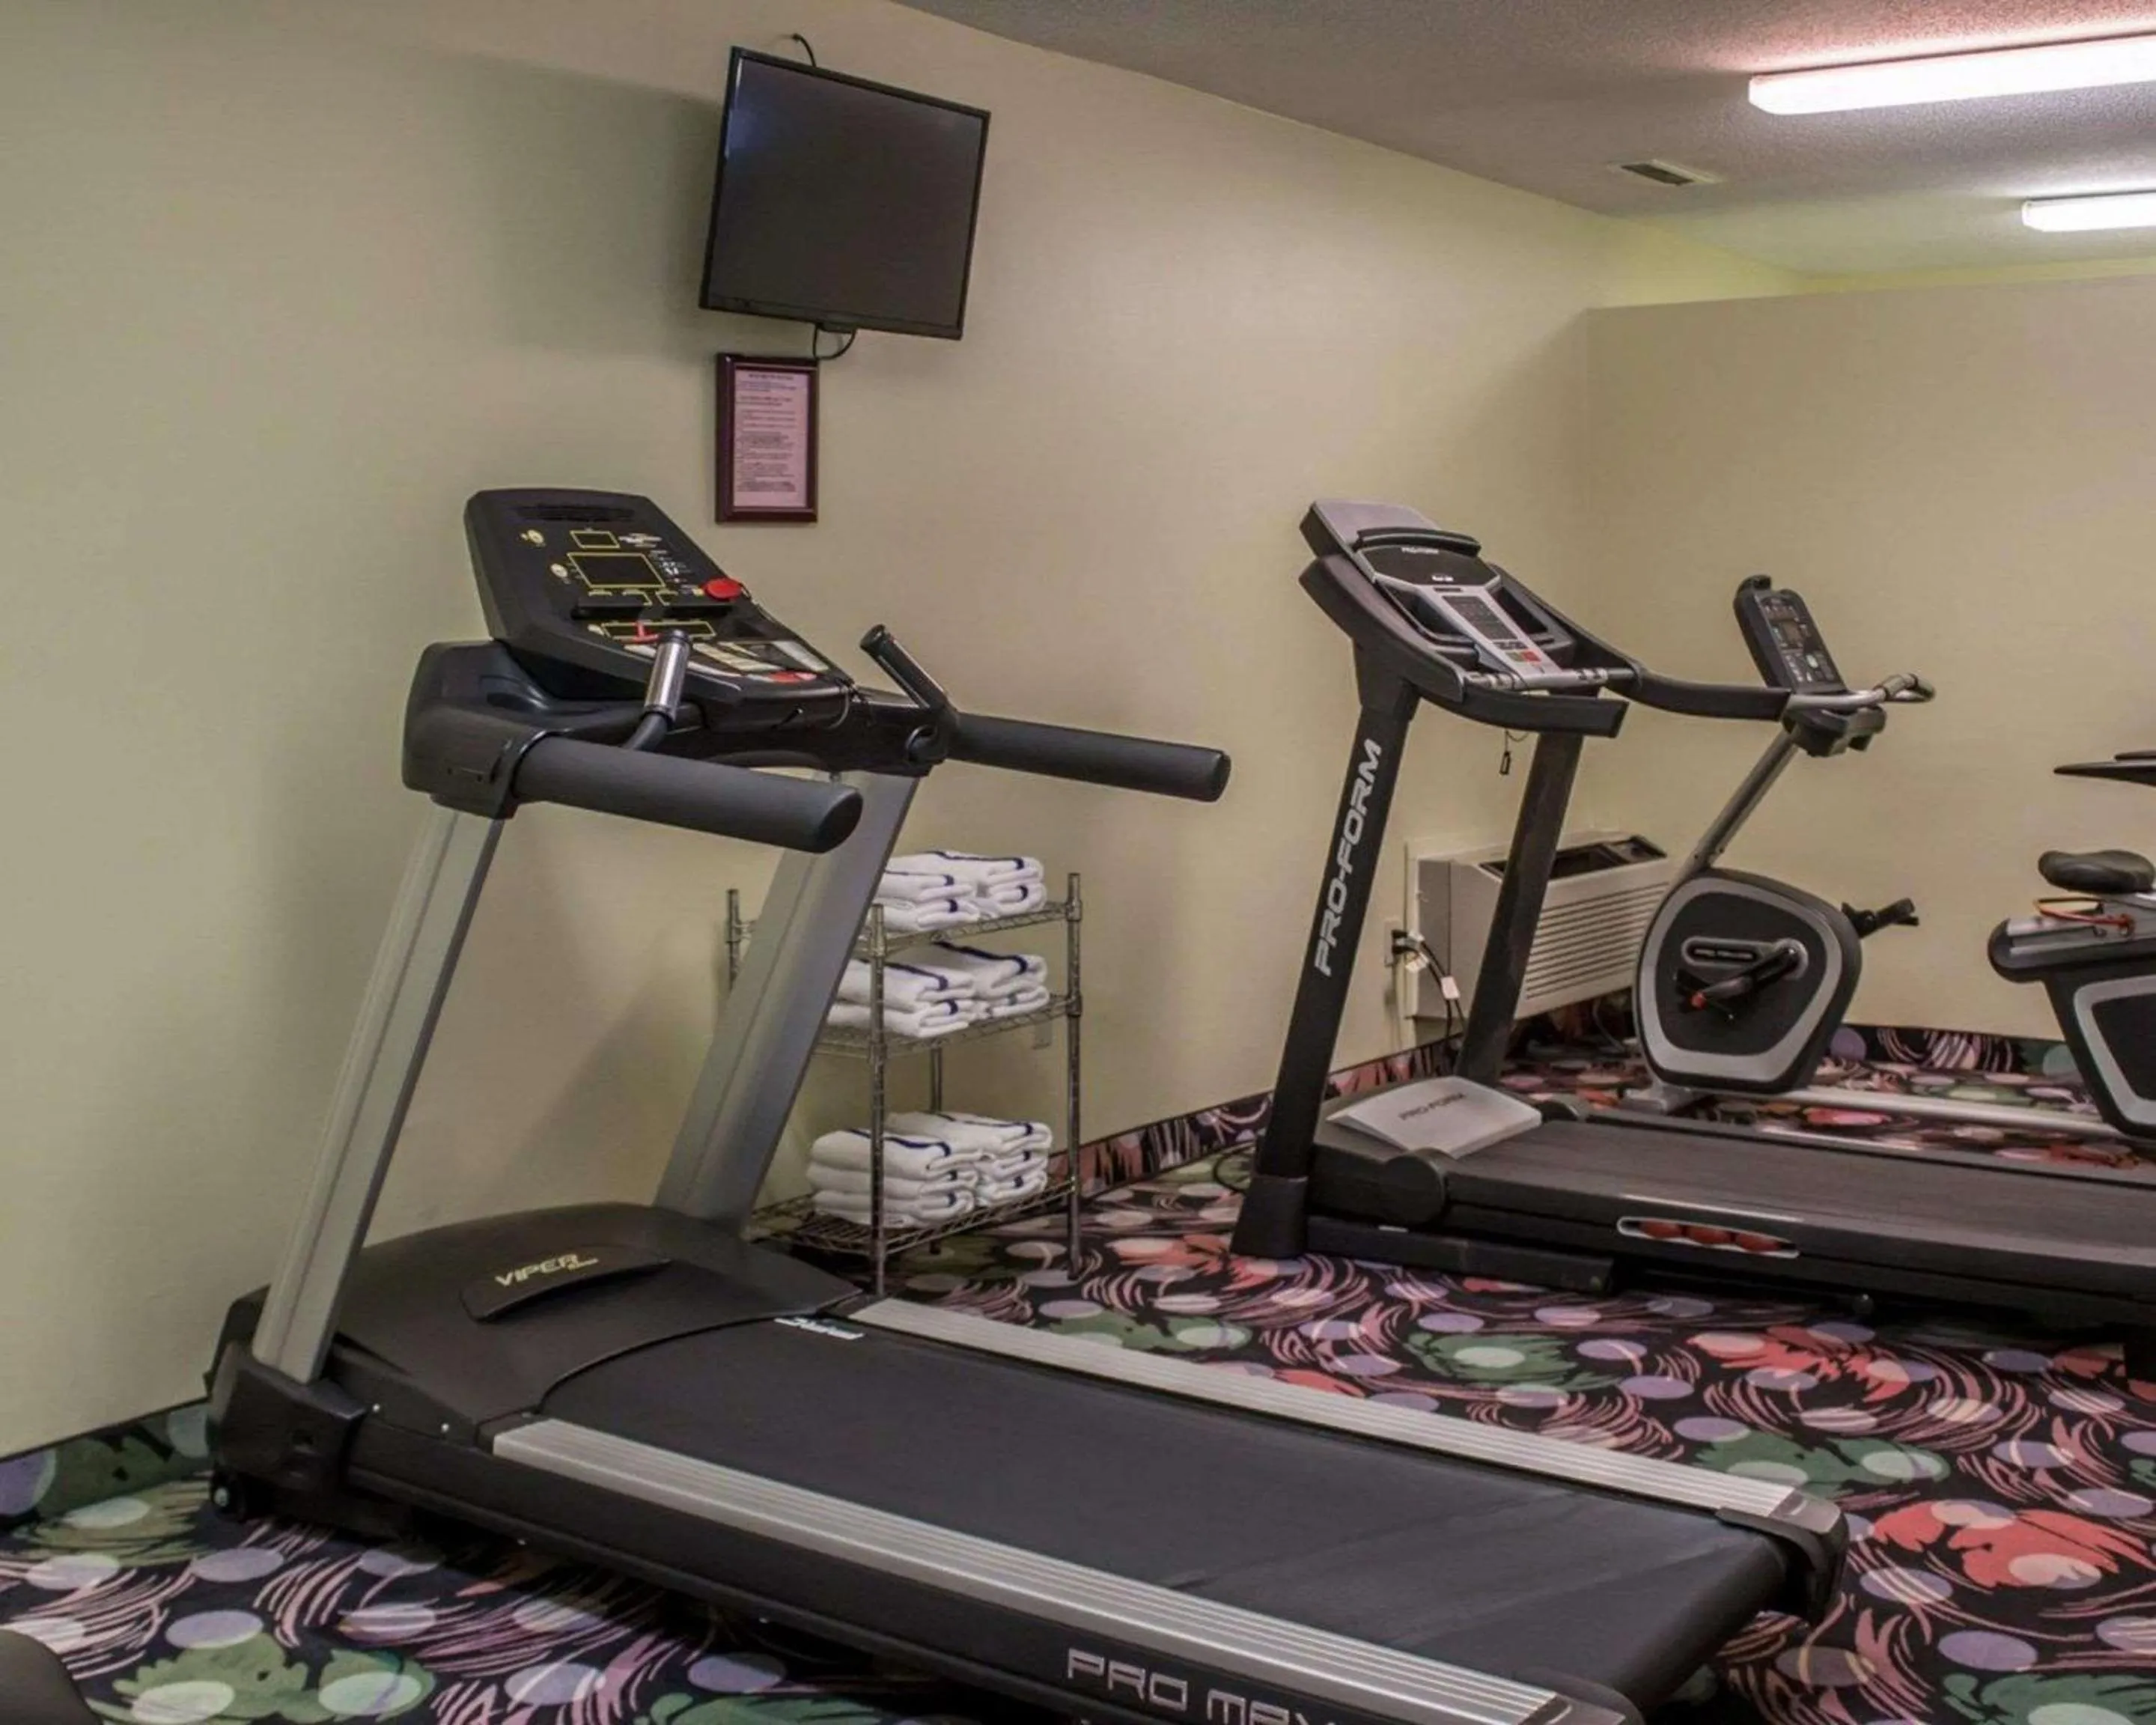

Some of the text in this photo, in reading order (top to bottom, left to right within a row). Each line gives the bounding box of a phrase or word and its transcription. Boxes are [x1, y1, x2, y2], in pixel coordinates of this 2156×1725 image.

[1315, 738, 1382, 976] PRO-FORM
[494, 1253, 578, 1286] VIPER
[1068, 1648, 1337, 1725] PRO MA
